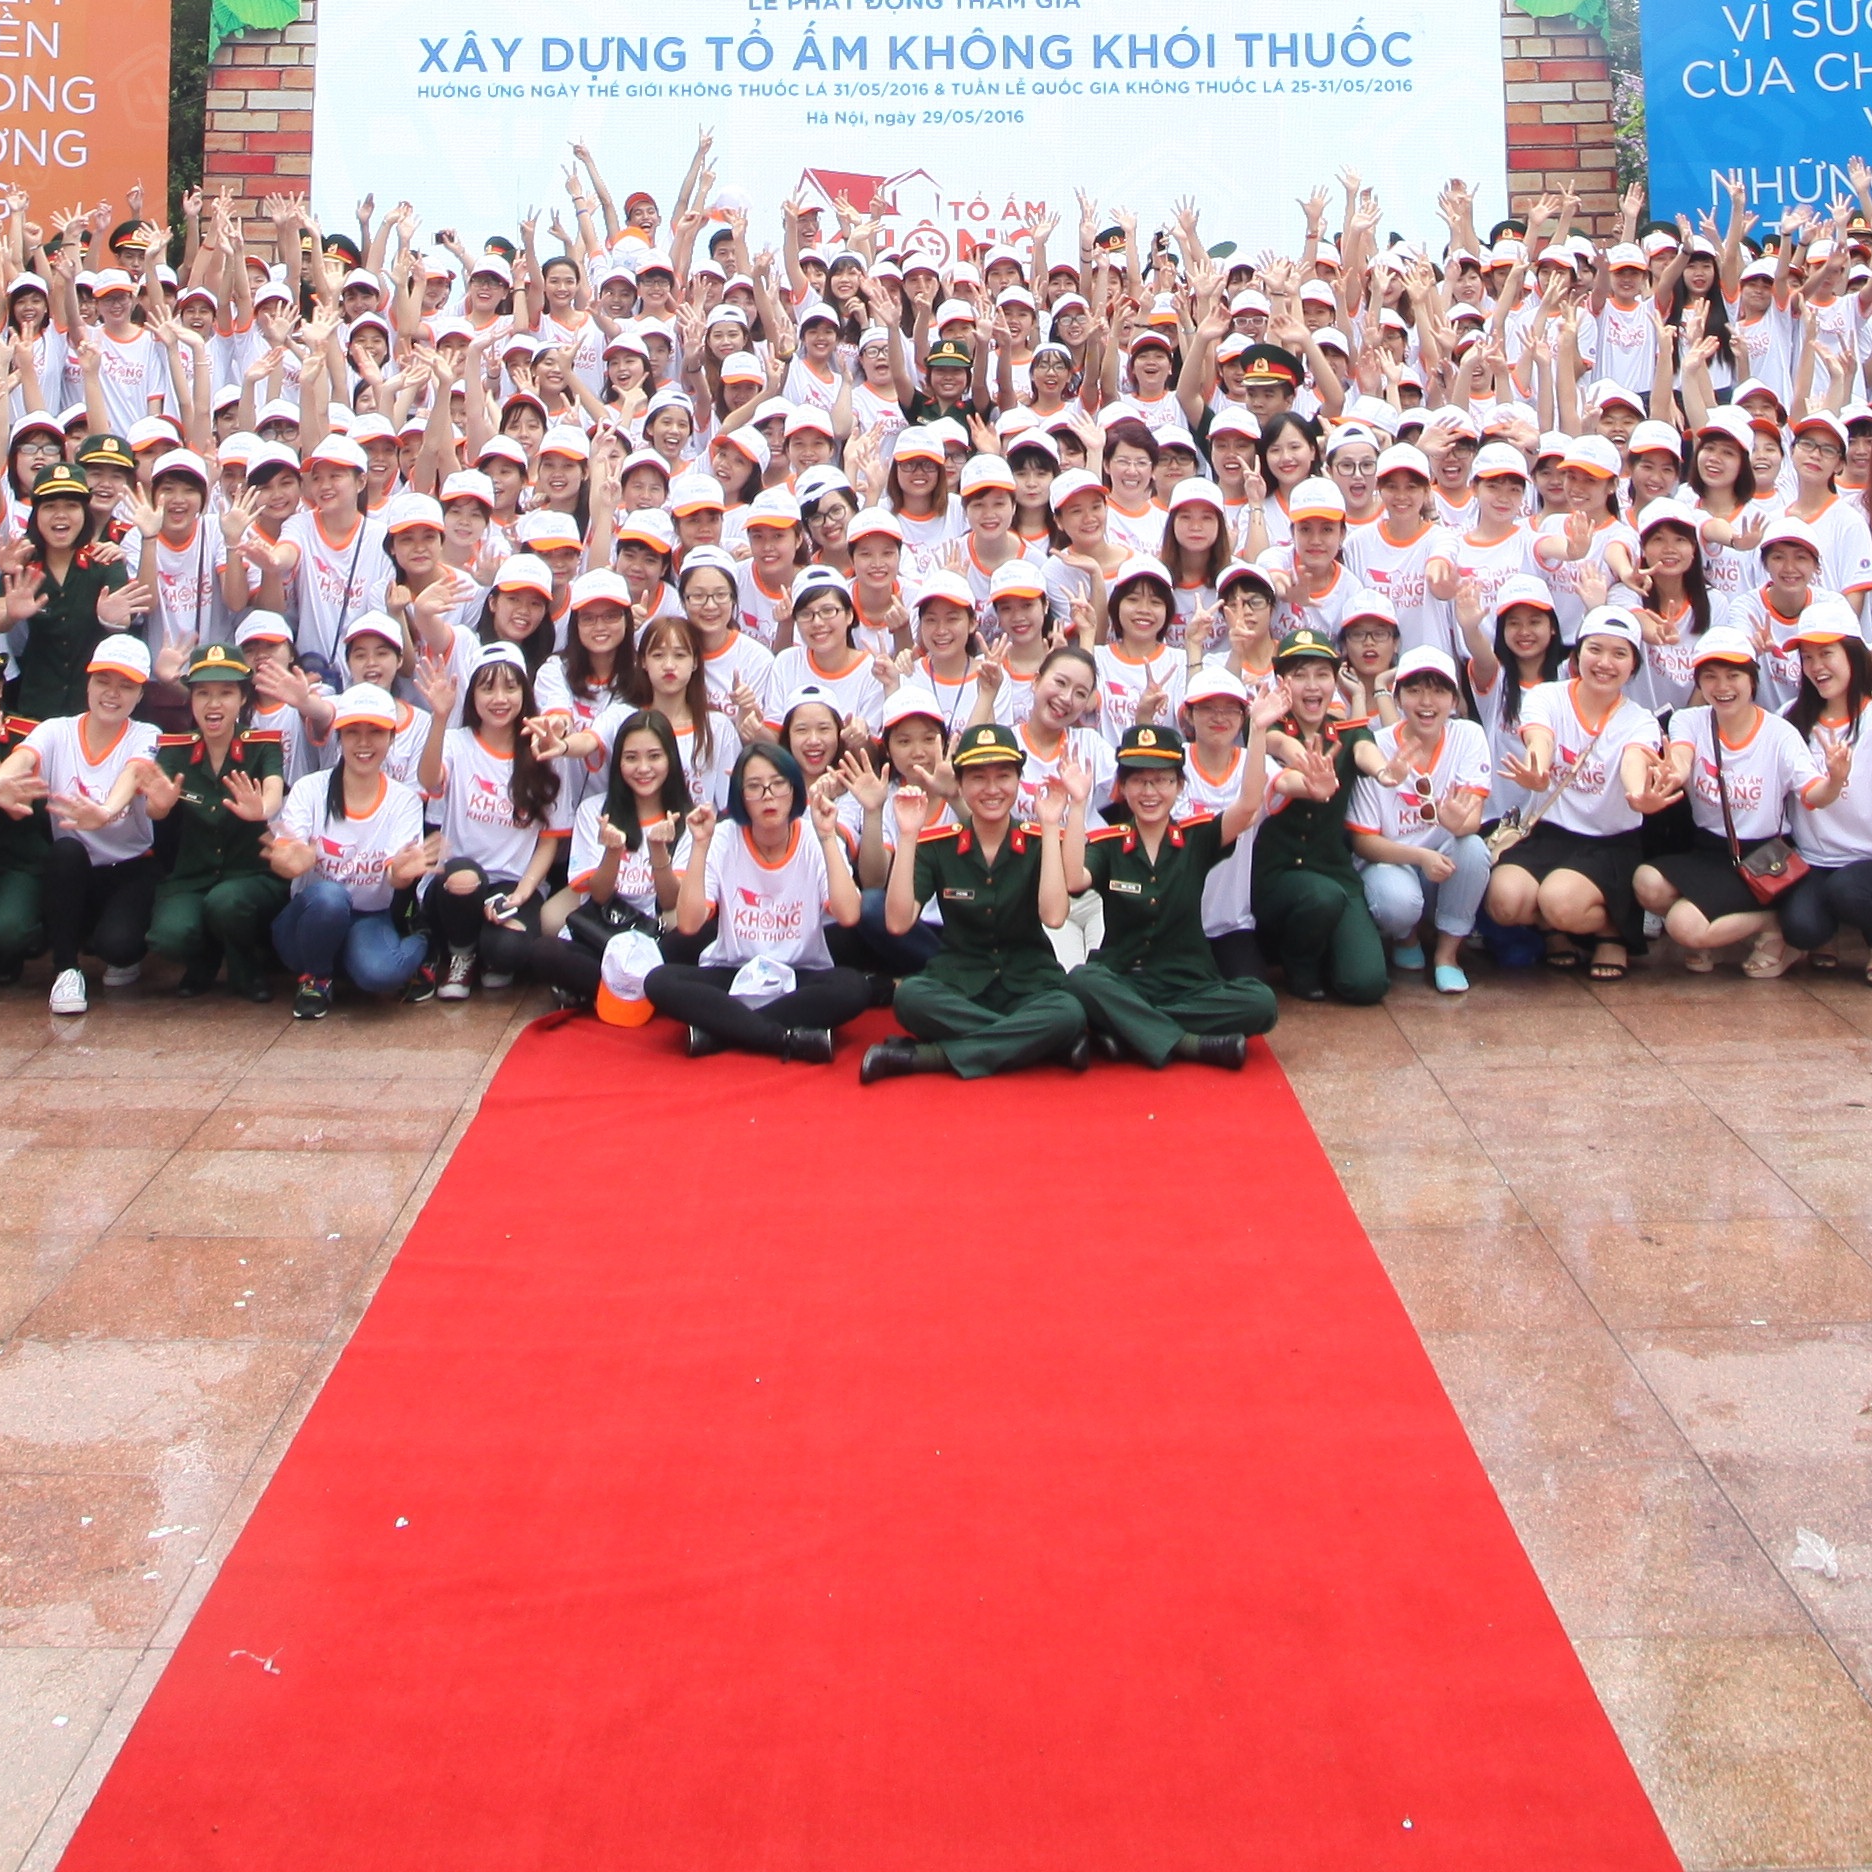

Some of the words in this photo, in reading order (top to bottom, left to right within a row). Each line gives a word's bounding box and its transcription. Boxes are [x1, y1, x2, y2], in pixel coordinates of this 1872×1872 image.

[419, 30, 523, 72] XÂY
[542, 37, 686, 81] DỰNG
[705, 18, 774, 72] TỔ
[793, 20, 867, 71] ẤM
[889, 27, 1072, 70] KHÔNG
[1093, 26, 1215, 69] KHÓI
[1235, 16, 1413, 68] THUỐC
[488, 85, 524, 98] ỨNG
[531, 83, 580, 97] NGÀY
[587, 81, 619, 97] THẾ
[626, 82, 662, 97] GIỚI
[669, 82, 732, 97] KHÔNG
[739, 79, 799, 96] THUỐC
[806, 82, 827, 96] LÁ
[834, 82, 928, 97] 31/05/2016
[934, 83, 945, 95] &
[952, 78, 999, 95] TUẦN
[1006, 78, 1026, 95] LỄ
[1032, 79, 1083, 95] QUỐC
[1090, 82, 1120, 94] GIA
[1126, 79, 1190, 94] KHÔNG
[1196, 76, 1256, 93] THUỐC
[1264, 79, 1285, 93] LÁ
[1292, 79, 1412, 94] 25-31/05/2016
[1683, 50, 1794, 98] CỦA
[807, 112, 828, 124] Hà
[835, 111, 868, 126] Nội,
[875, 112, 916, 126] ngày
[923, 109, 1024, 125] 29/05/2016
[948, 191, 989, 221] TỔ
